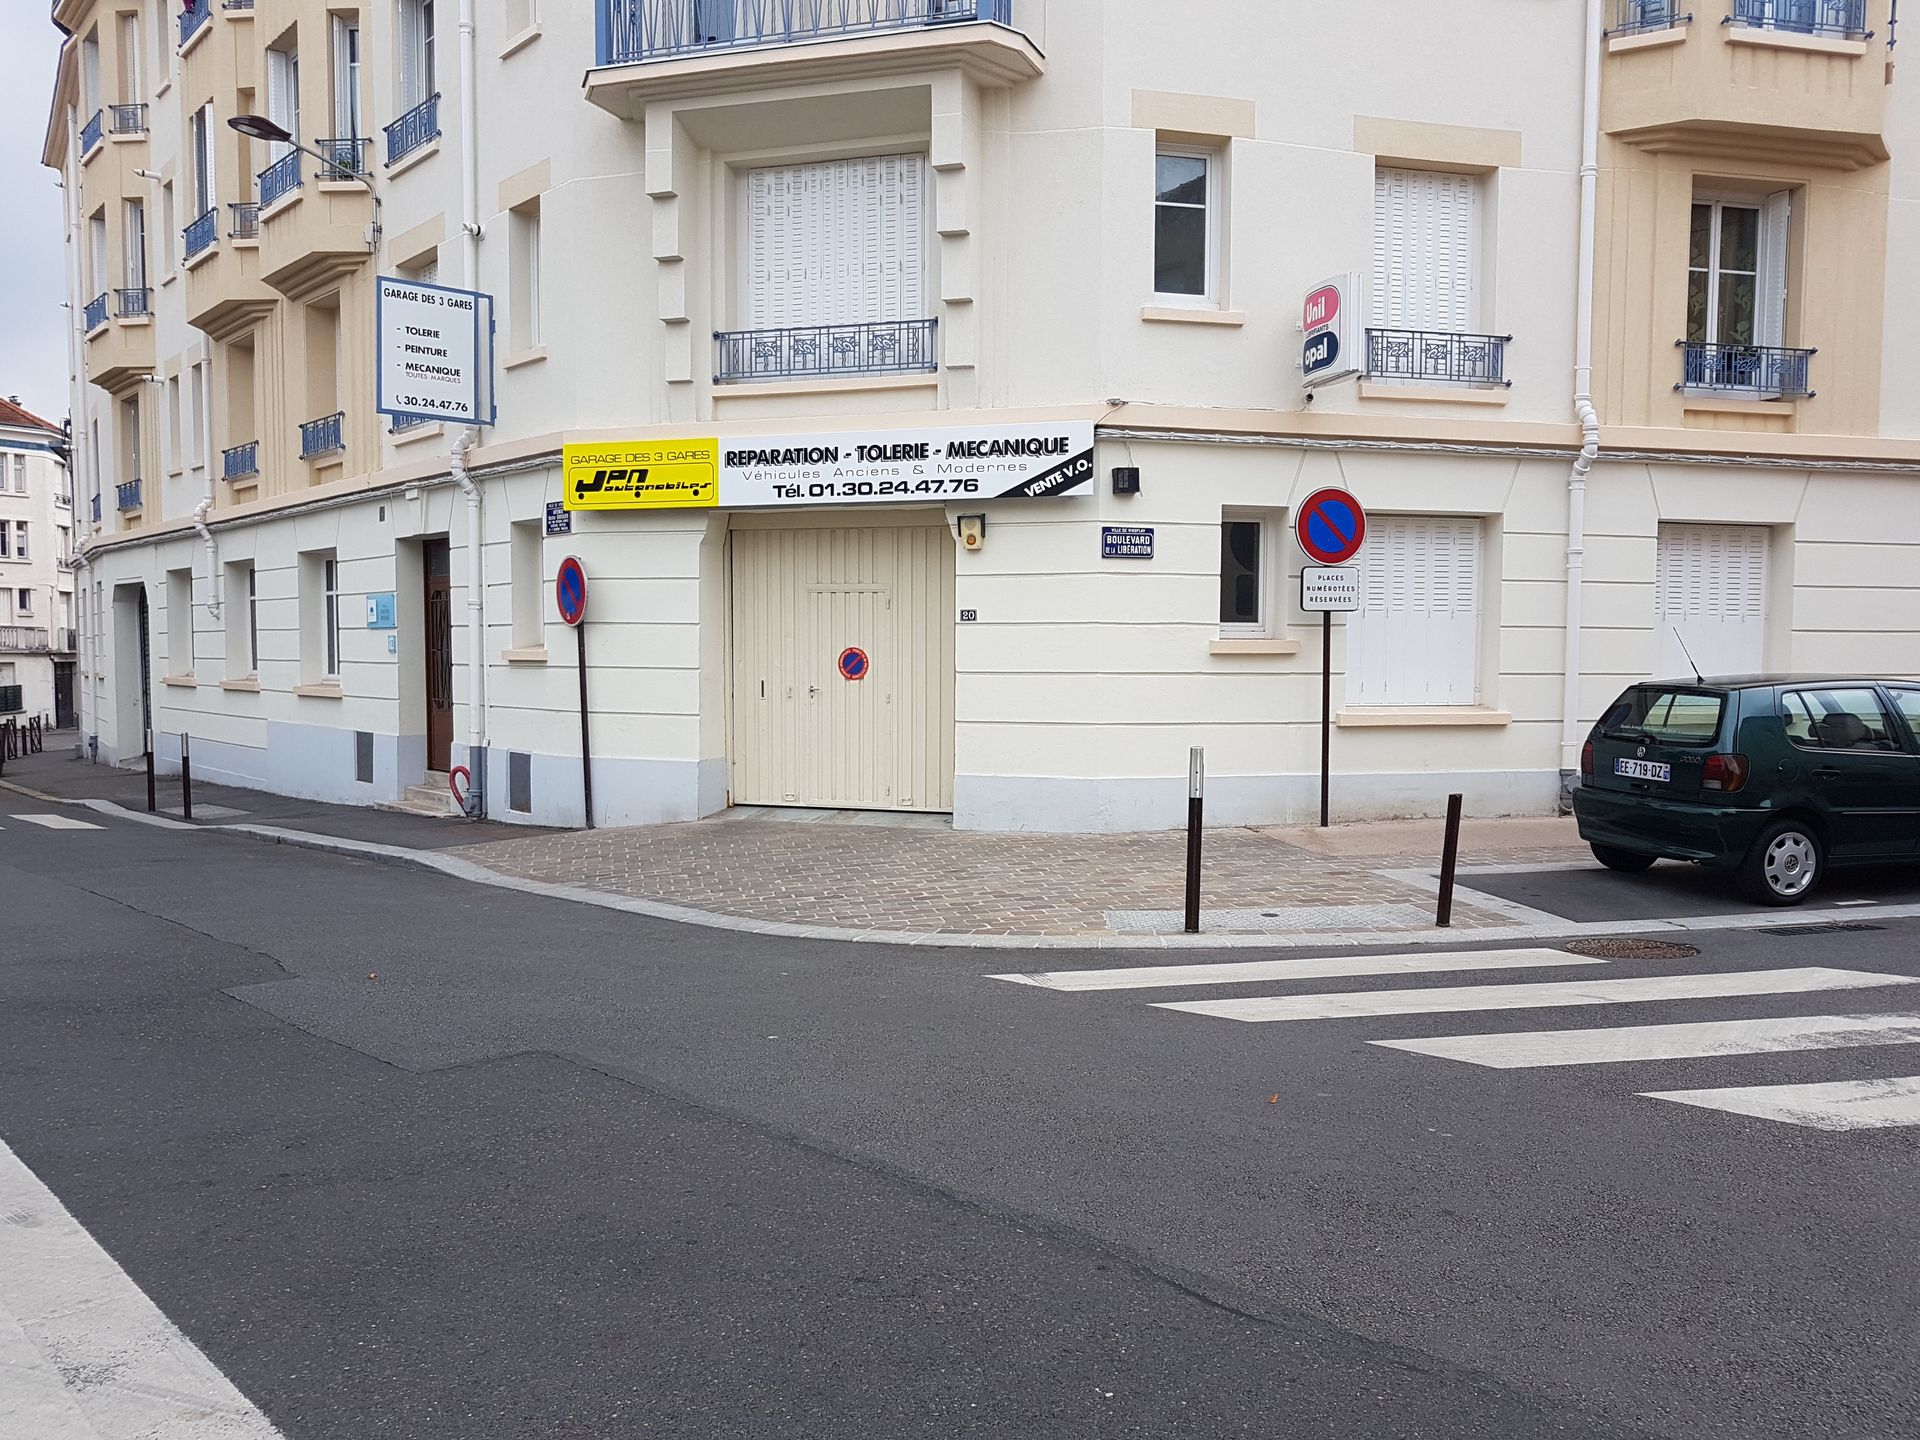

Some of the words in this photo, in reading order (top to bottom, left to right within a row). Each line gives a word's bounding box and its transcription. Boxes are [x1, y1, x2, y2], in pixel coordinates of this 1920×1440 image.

[384, 288, 418, 302] GARAGE
[421, 294, 436, 305] DES
[439, 297, 444, 306] 3
[447, 298, 473, 310] GARES
[1306, 296, 1325, 324] Unil
[405, 326, 440, 339] TOLERIE
[405, 344, 447, 358] PEINTURE
[1305, 337, 1328, 368] opal
[405, 362, 461, 377] MECANIQUE
[405, 371, 428, 380] TOUTES
[430, 375, 461, 384] MARQUES
[403, 395, 468, 412] 30.24.47.76
[571, 454, 622, 464] GARAGE
[626, 453, 650, 462] DES
[654, 452, 663, 461] 3
[667, 450, 710, 460] GARES
[725, 446, 838, 468] REPARATION
[855, 443, 929, 464] TOLERIE
[945, 437, 1069, 459] MECANIQUE
[742, 469, 821, 481] Véhicules
[833, 467, 900, 478] Anciens
[912, 464, 924, 475] &
[937, 463, 1028, 474] Modernes
[1024, 471, 1064, 497] VENTE
[1063, 459, 1092, 478] V.O.
[773, 483, 805, 498] Tél.
[808, 479, 979, 497] 01.30.24.47.76
[1106, 535, 1150, 545] BOULEVARD
[962, 611, 975, 620] 20
[1619, 760, 1663, 778] EE-719-DZ
